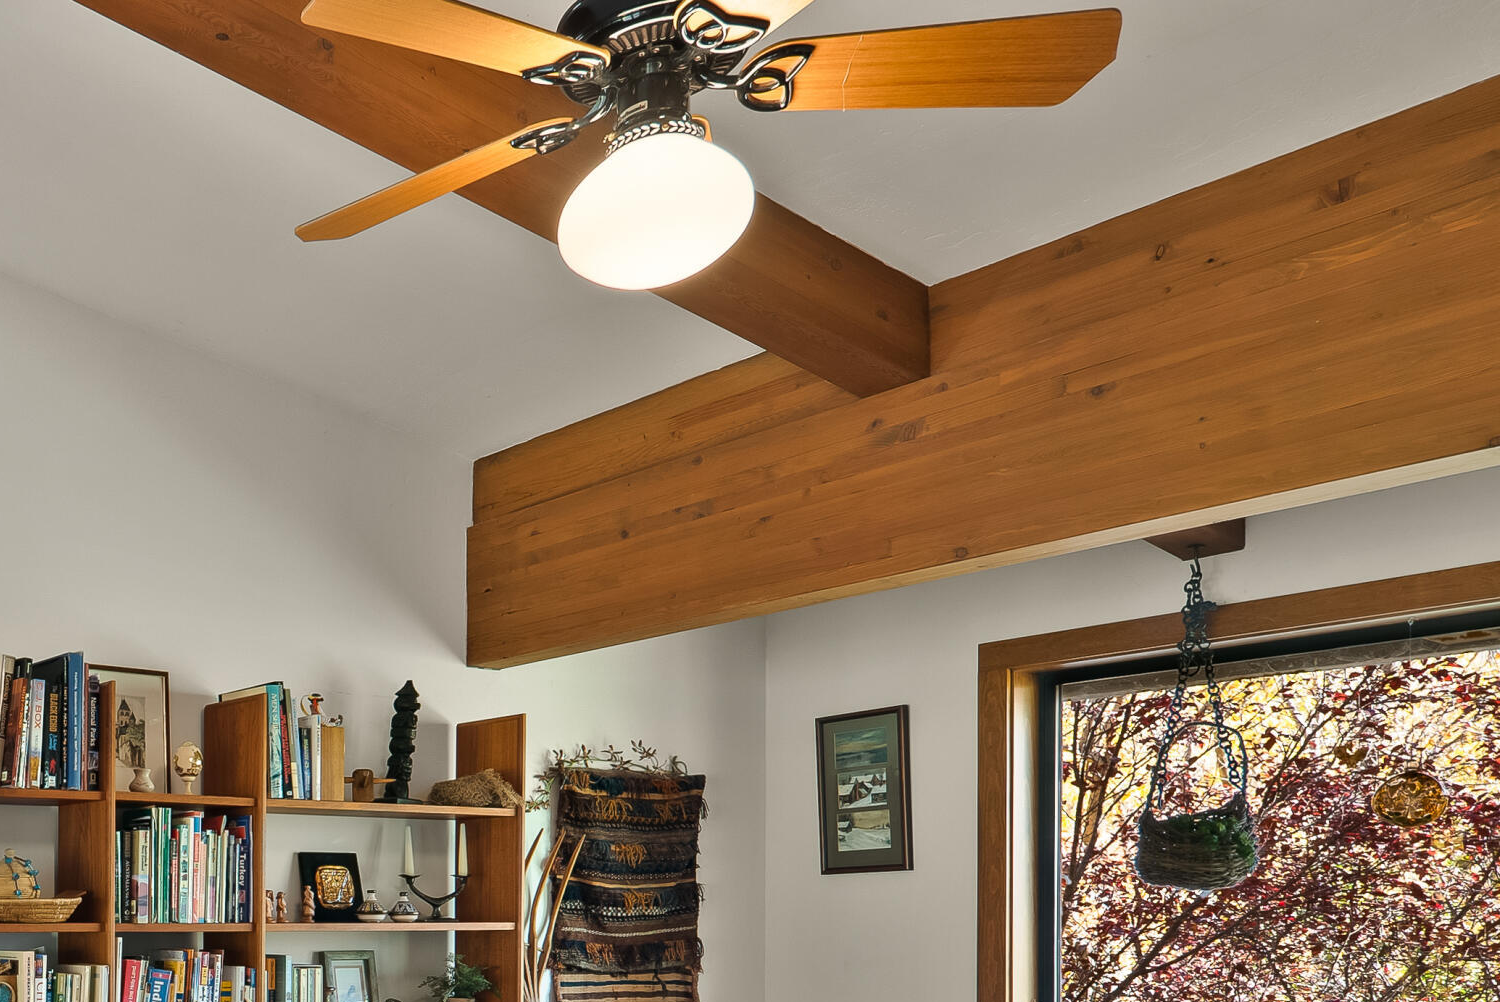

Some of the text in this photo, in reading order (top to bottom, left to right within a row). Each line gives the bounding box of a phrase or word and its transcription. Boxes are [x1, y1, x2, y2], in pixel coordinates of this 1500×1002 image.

[49, 692, 59, 715] BLACK
[34, 704, 42, 729] BOX
[49, 715, 58, 733] ECHO
[89, 696, 98, 747] National Parks
[238, 853, 247, 886] Turkey
